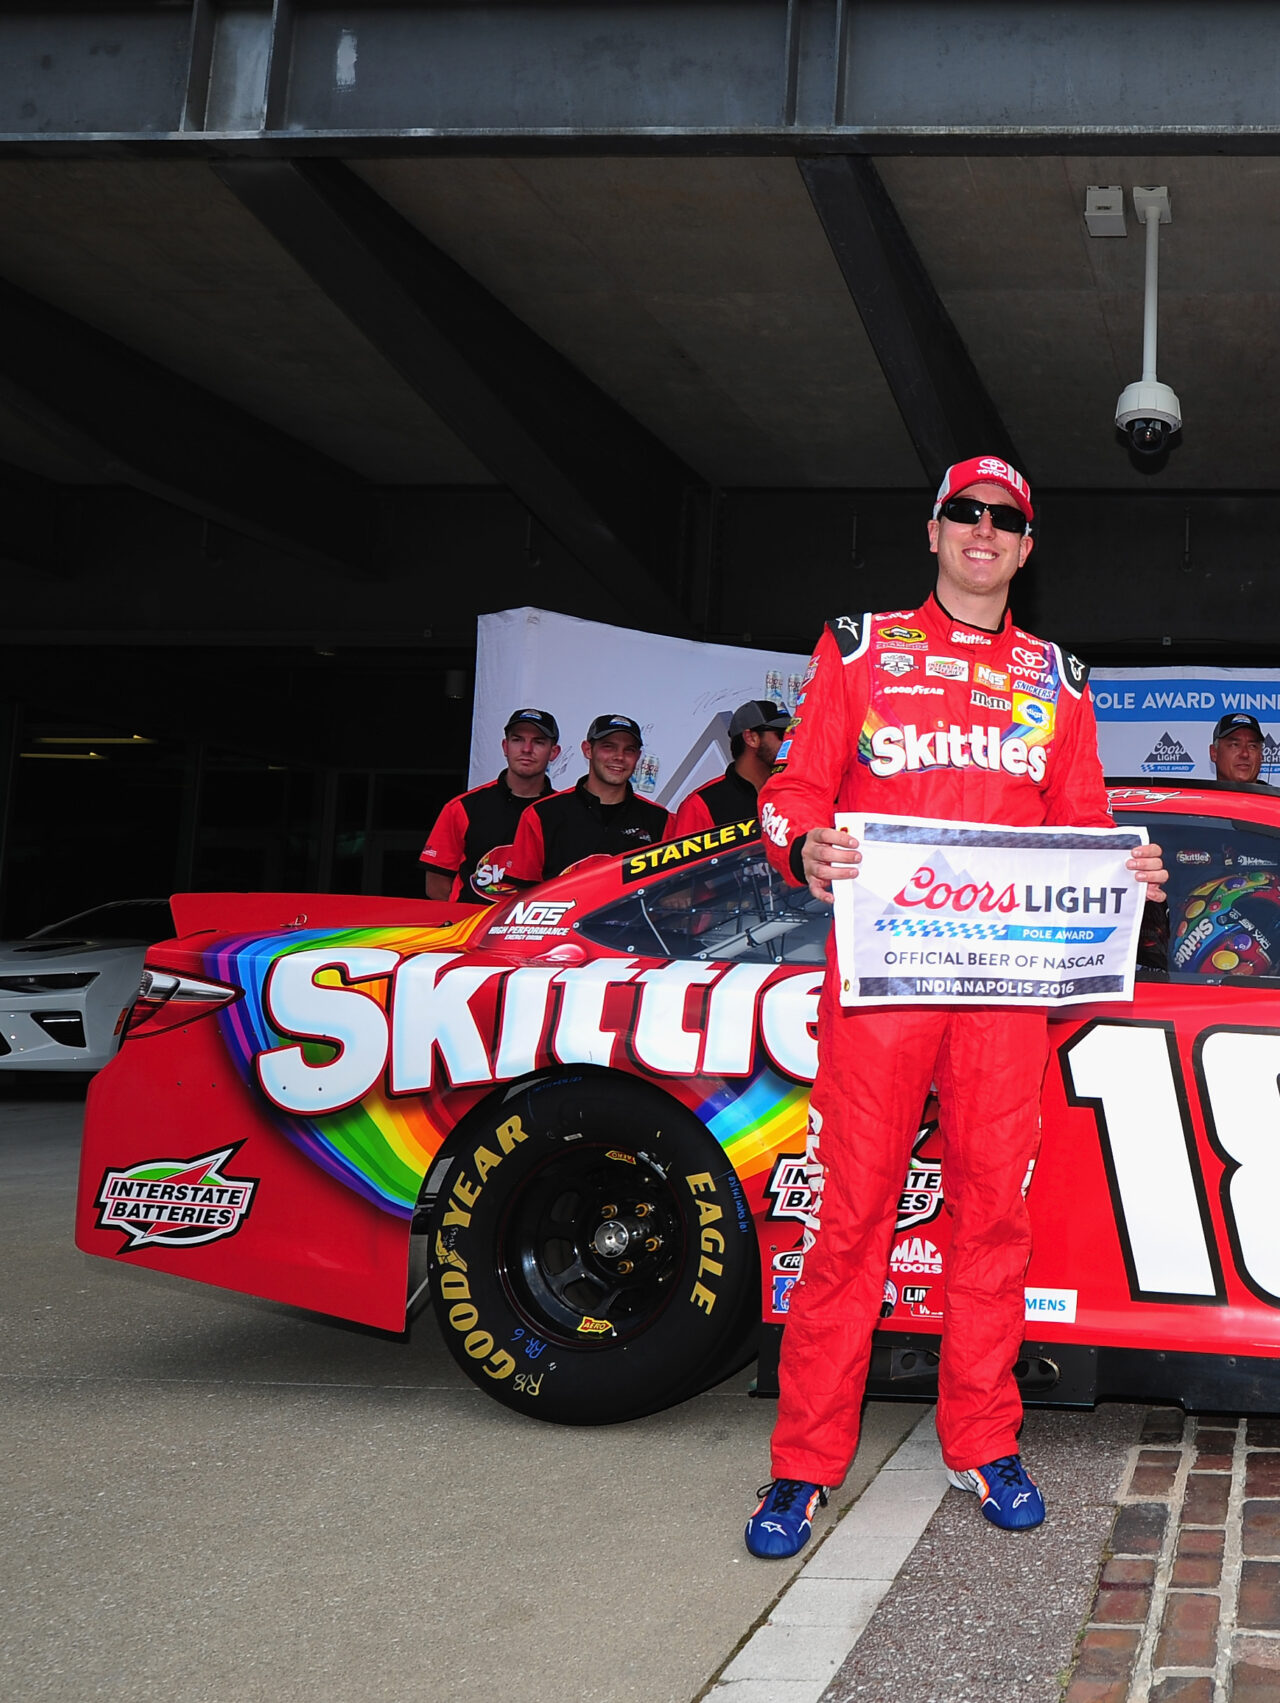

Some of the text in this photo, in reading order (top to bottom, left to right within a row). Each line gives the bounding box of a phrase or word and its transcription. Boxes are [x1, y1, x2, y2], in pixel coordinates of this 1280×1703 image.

[951, 631, 992, 646] Skittles
[1006, 664, 1055, 685] TOYOTA
[884, 685, 944, 695] GOODYEAR
[1016, 680, 1053, 698] SNICKERS
[1091, 692, 1135, 709] OLE
[1142, 692, 1215, 709] AWARD
[869, 720, 1047, 784] Skittles
[1152, 741, 1185, 755] Coors
[630, 820, 755, 874] STANLEY
[1179, 853, 1210, 862] Skittles
[893, 866, 1128, 914] Coors LIGHT
[504, 899, 576, 925] NOS
[488, 926, 570, 936] HIGH PERFORMANCE
[1023, 929, 1094, 941] POLE AWARD
[1174, 918, 1214, 968] Skittles
[884, 951, 1105, 970] OFFICIAL BEER OF NASCAR
[916, 979, 1074, 996] INDIANAPOLIS 2016
[257, 948, 821, 1115] Skittle
[110, 1181, 243, 1205] INTERSTATE
[112, 1202, 233, 1225] BATTERIES
[436, 1115, 529, 1380] GOODYEAR
[685, 1171, 727, 1315] EAGLE
[890, 1238, 943, 1264] MAC
[890, 1263, 943, 1275] TOOLS
[1025, 1298, 1067, 1312] MENS
[583, 1321, 608, 1331] AERO
